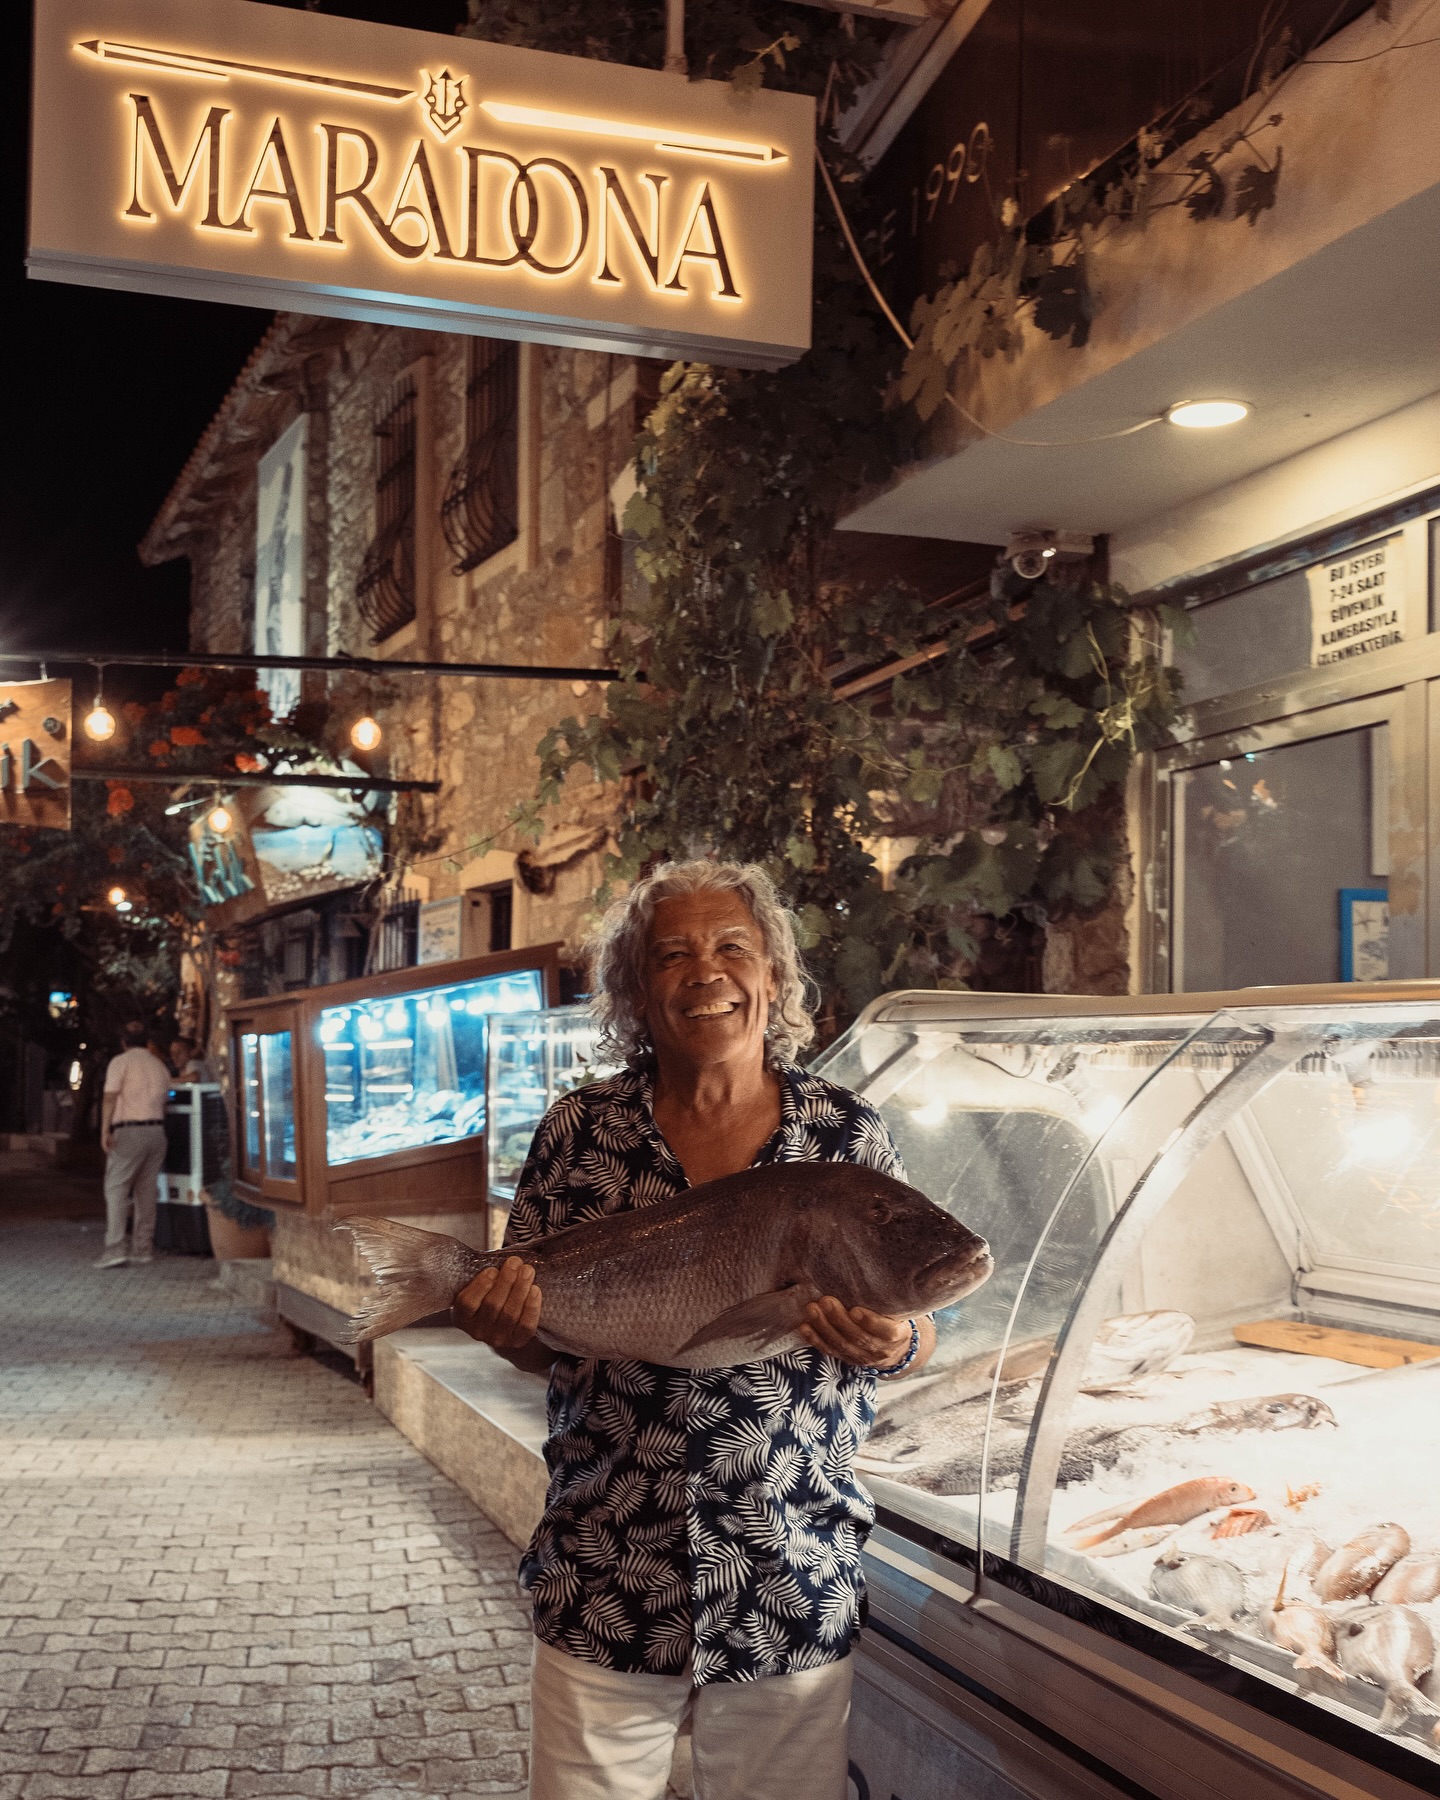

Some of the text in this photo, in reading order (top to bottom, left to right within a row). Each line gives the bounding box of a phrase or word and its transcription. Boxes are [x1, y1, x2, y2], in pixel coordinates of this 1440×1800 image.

[122, 92, 745, 304] MARADONA
[1330, 565, 1346, 583] BU
[1357, 571, 1386, 593] SAAT
